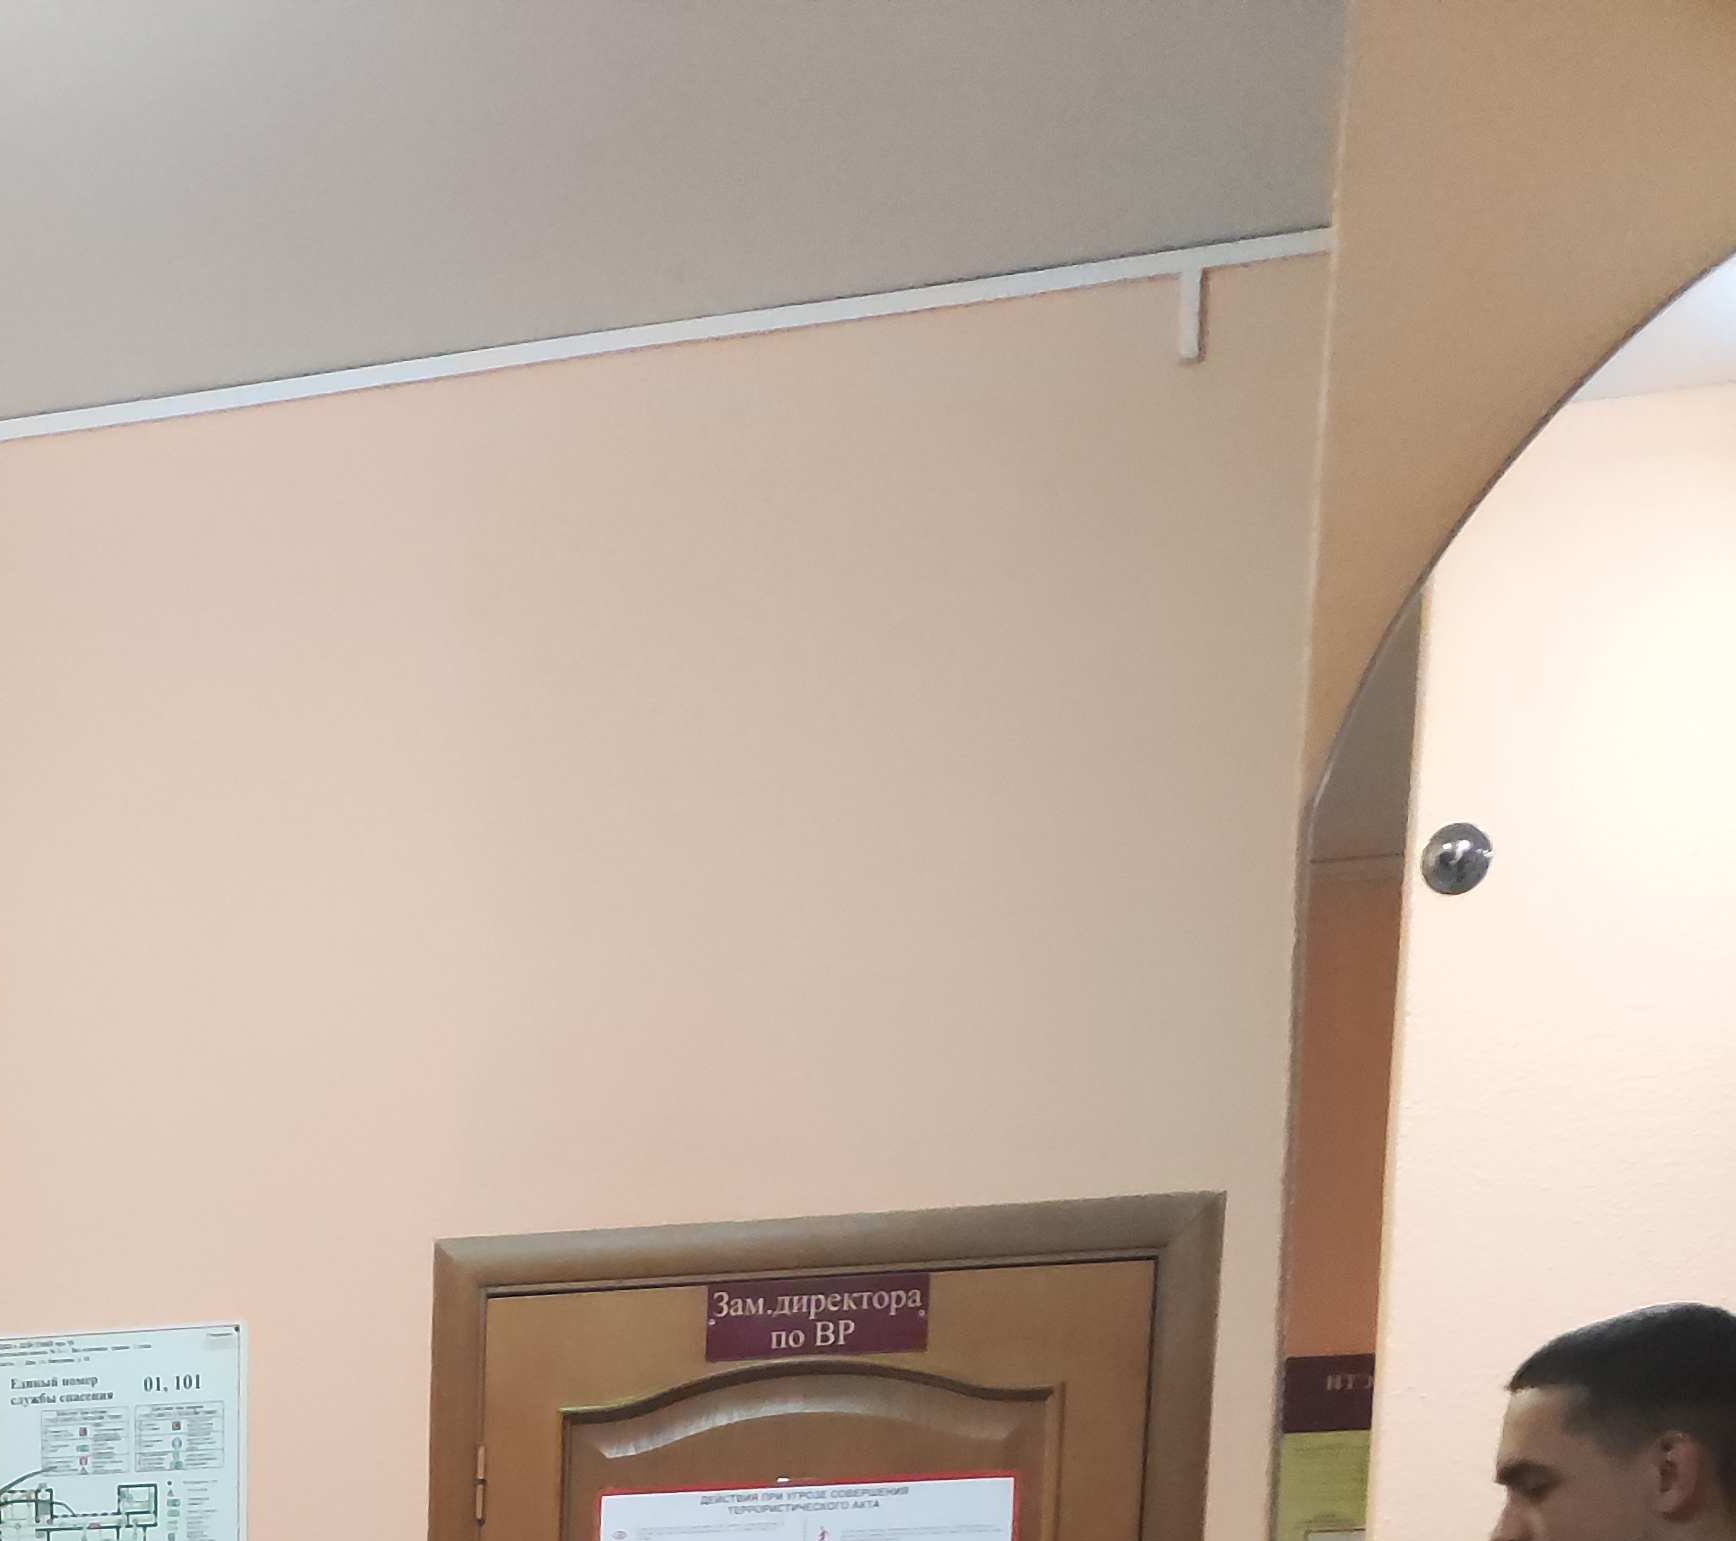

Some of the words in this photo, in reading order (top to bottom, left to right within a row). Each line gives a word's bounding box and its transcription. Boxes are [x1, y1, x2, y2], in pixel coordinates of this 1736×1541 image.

[714, 1288, 922, 1320] Зам.директора
[771, 1330, 805, 1349] по
[815, 1320, 855, 1346] ВР
[11, 1378, 58, 1389] Единый
[63, 1377, 99, 1388] номер
[175, 1374, 202, 1391] 101
[11, 1393, 56, 1407] службы
[60, 1391, 114, 1402] спасения
